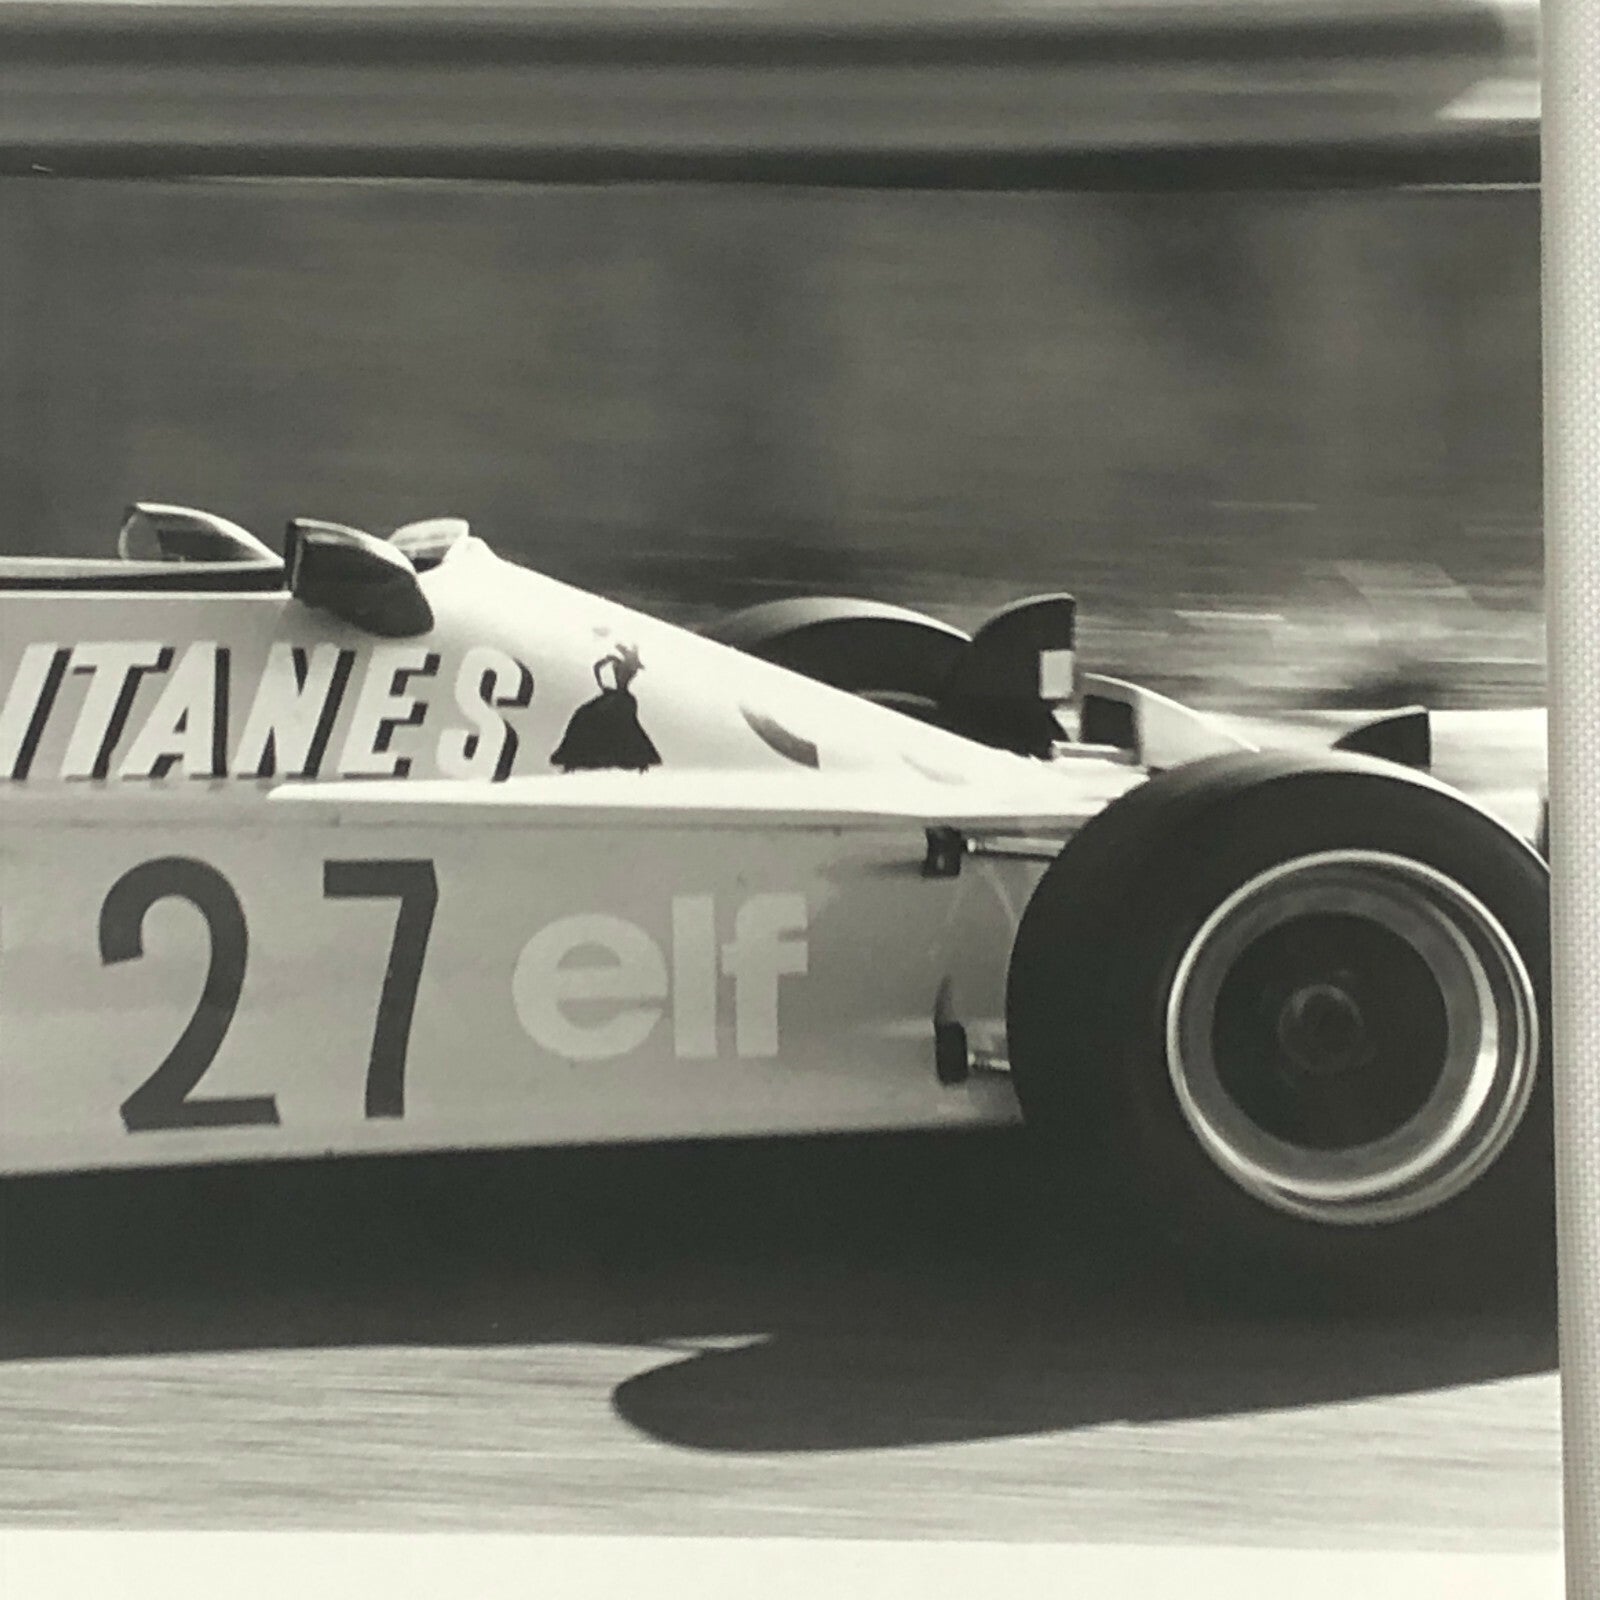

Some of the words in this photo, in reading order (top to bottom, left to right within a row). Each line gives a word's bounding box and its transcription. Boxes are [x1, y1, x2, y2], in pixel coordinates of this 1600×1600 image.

[0, 641, 534, 782] ITANES
[98, 855, 439, 1133] 27
[511, 892, 808, 1061] elf
